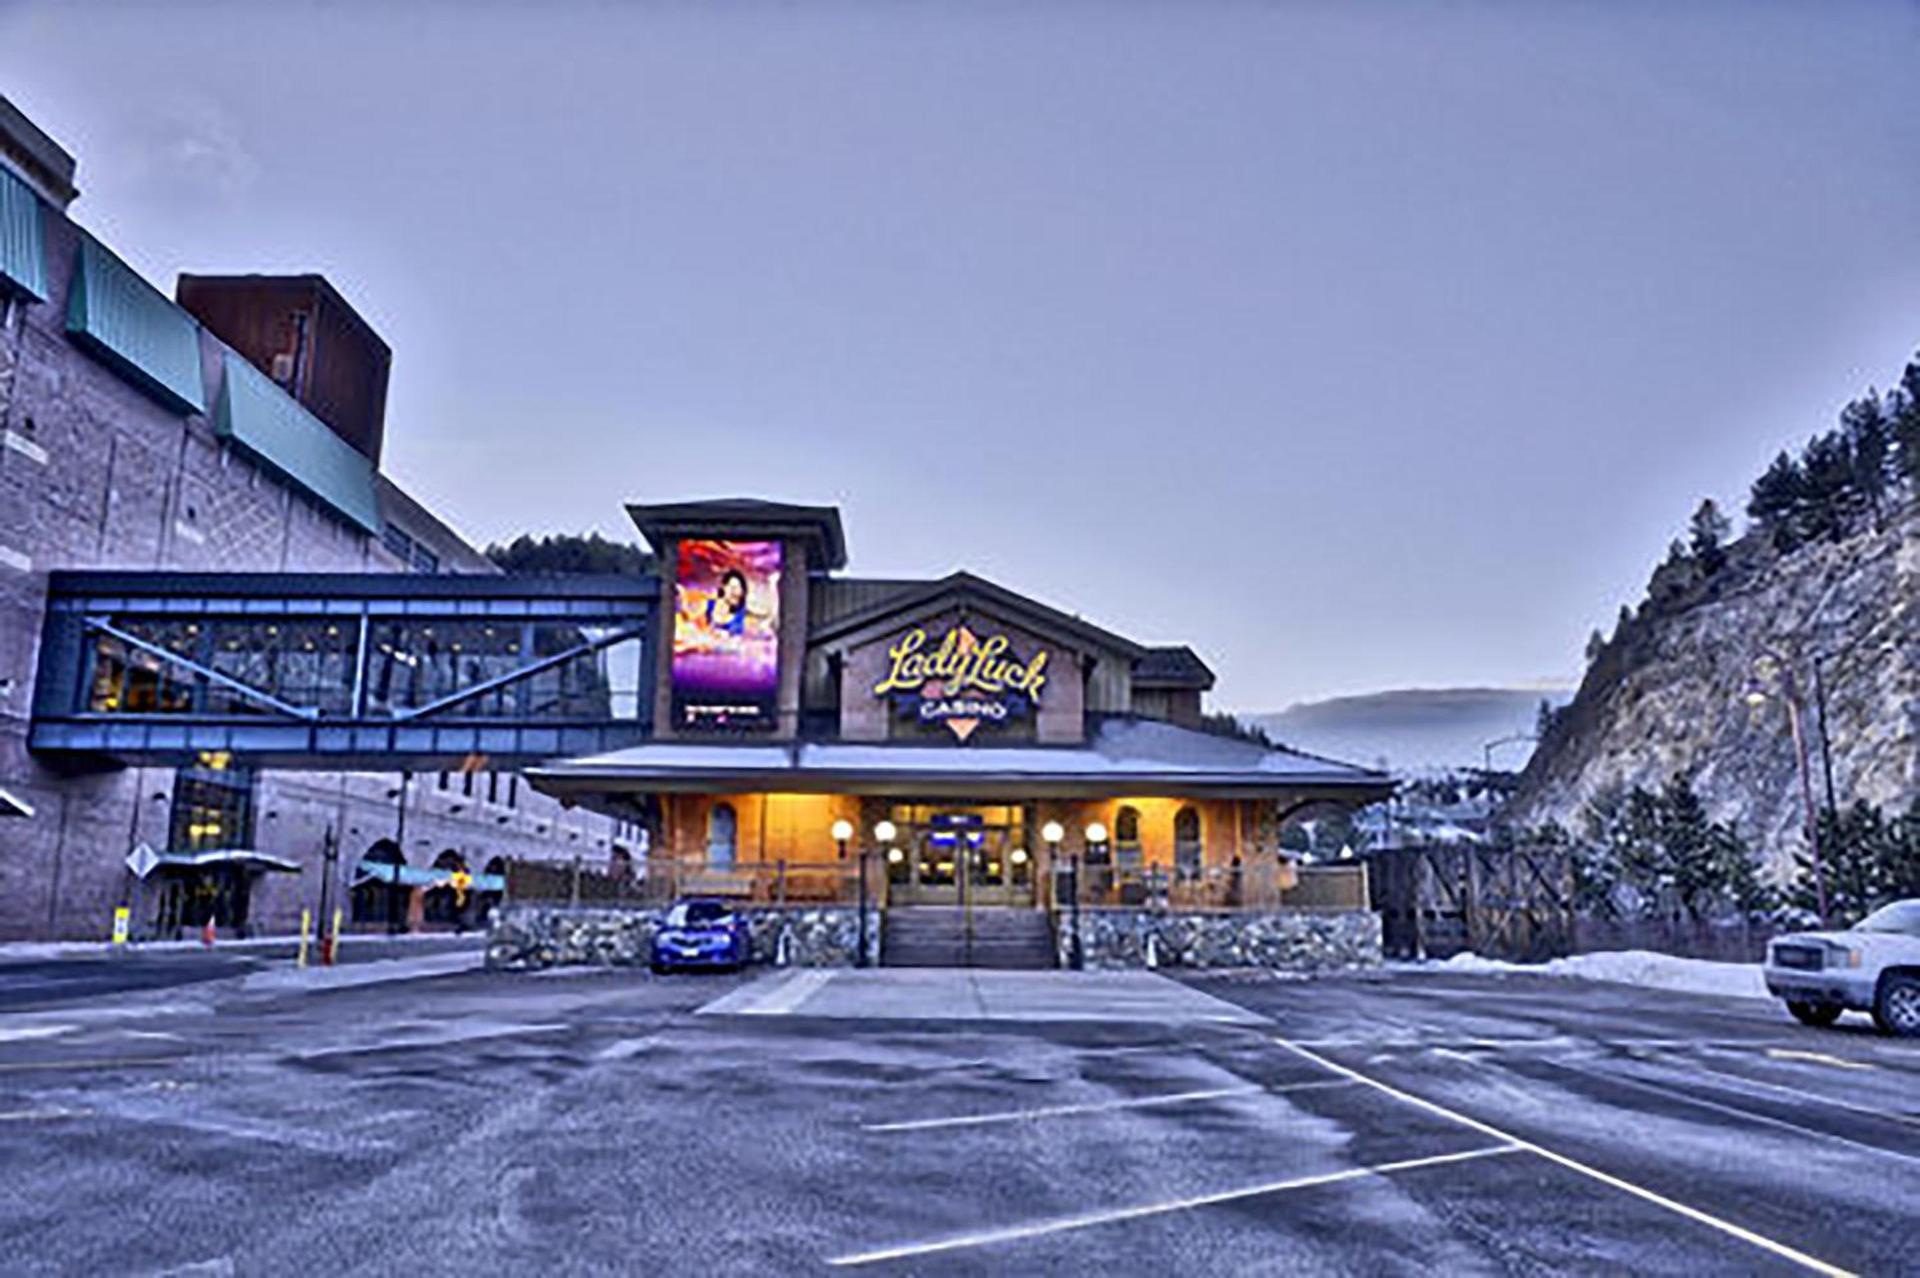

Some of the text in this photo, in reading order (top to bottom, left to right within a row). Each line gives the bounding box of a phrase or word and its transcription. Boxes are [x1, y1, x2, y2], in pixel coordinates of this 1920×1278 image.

[874, 629, 1047, 703] Lady Luck
[920, 701, 1007, 719] CASINO
